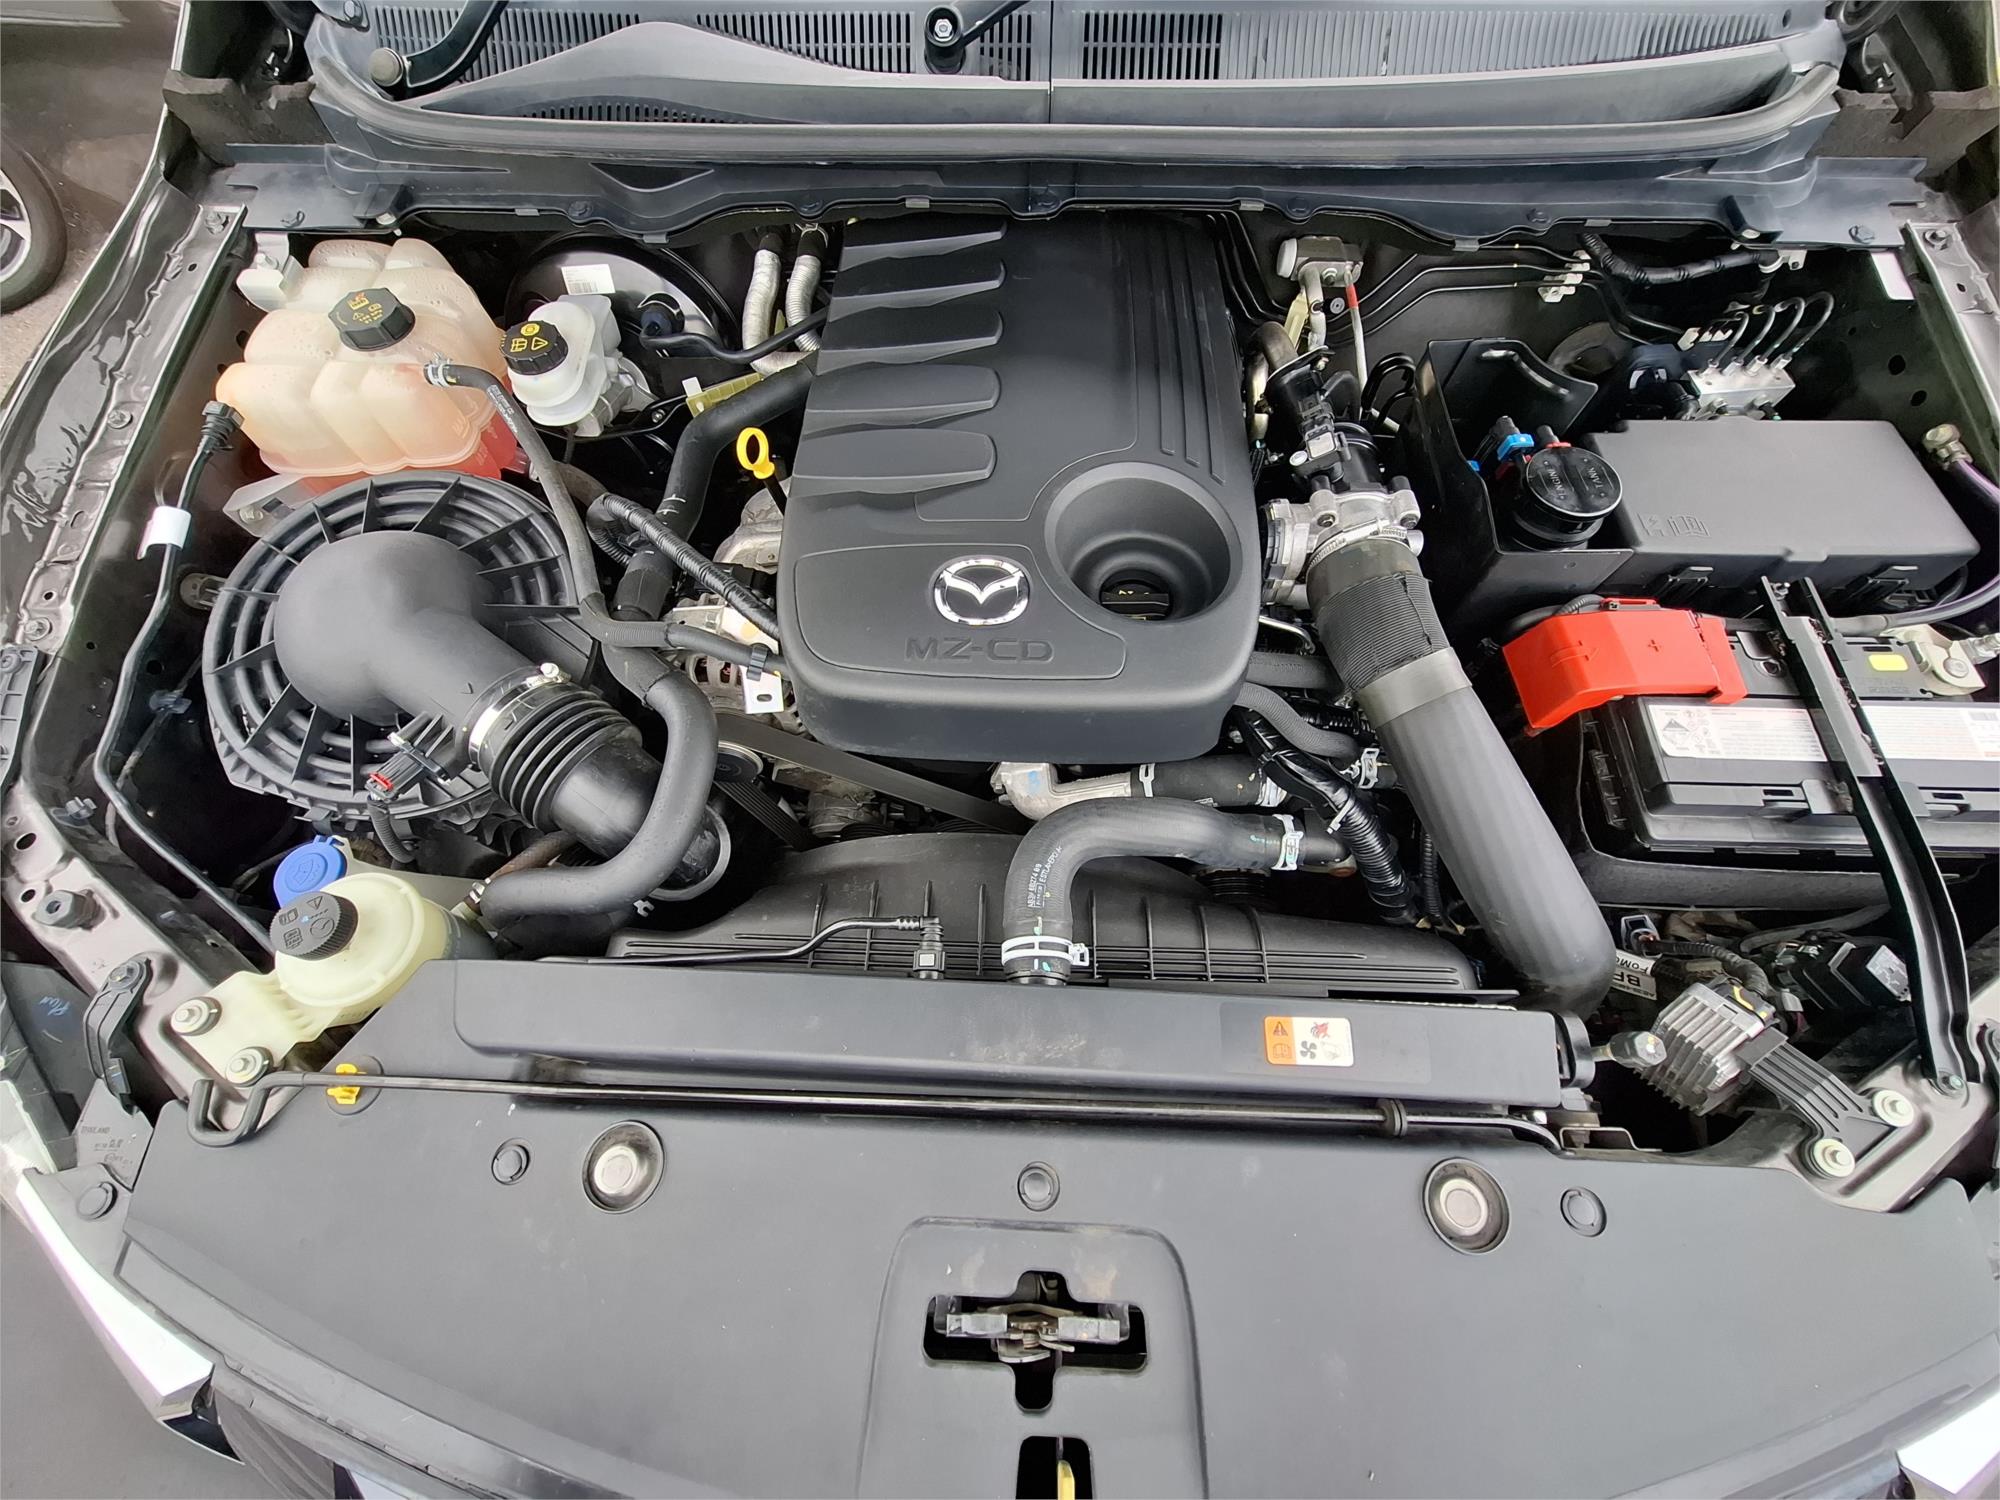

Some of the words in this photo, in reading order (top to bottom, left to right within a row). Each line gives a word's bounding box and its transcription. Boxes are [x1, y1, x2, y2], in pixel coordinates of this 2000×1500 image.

[1547, 468, 1566, 496] ENGINE
[1587, 467, 1604, 488] TANK
[904, 636, 1054, 663] MZ-CD
